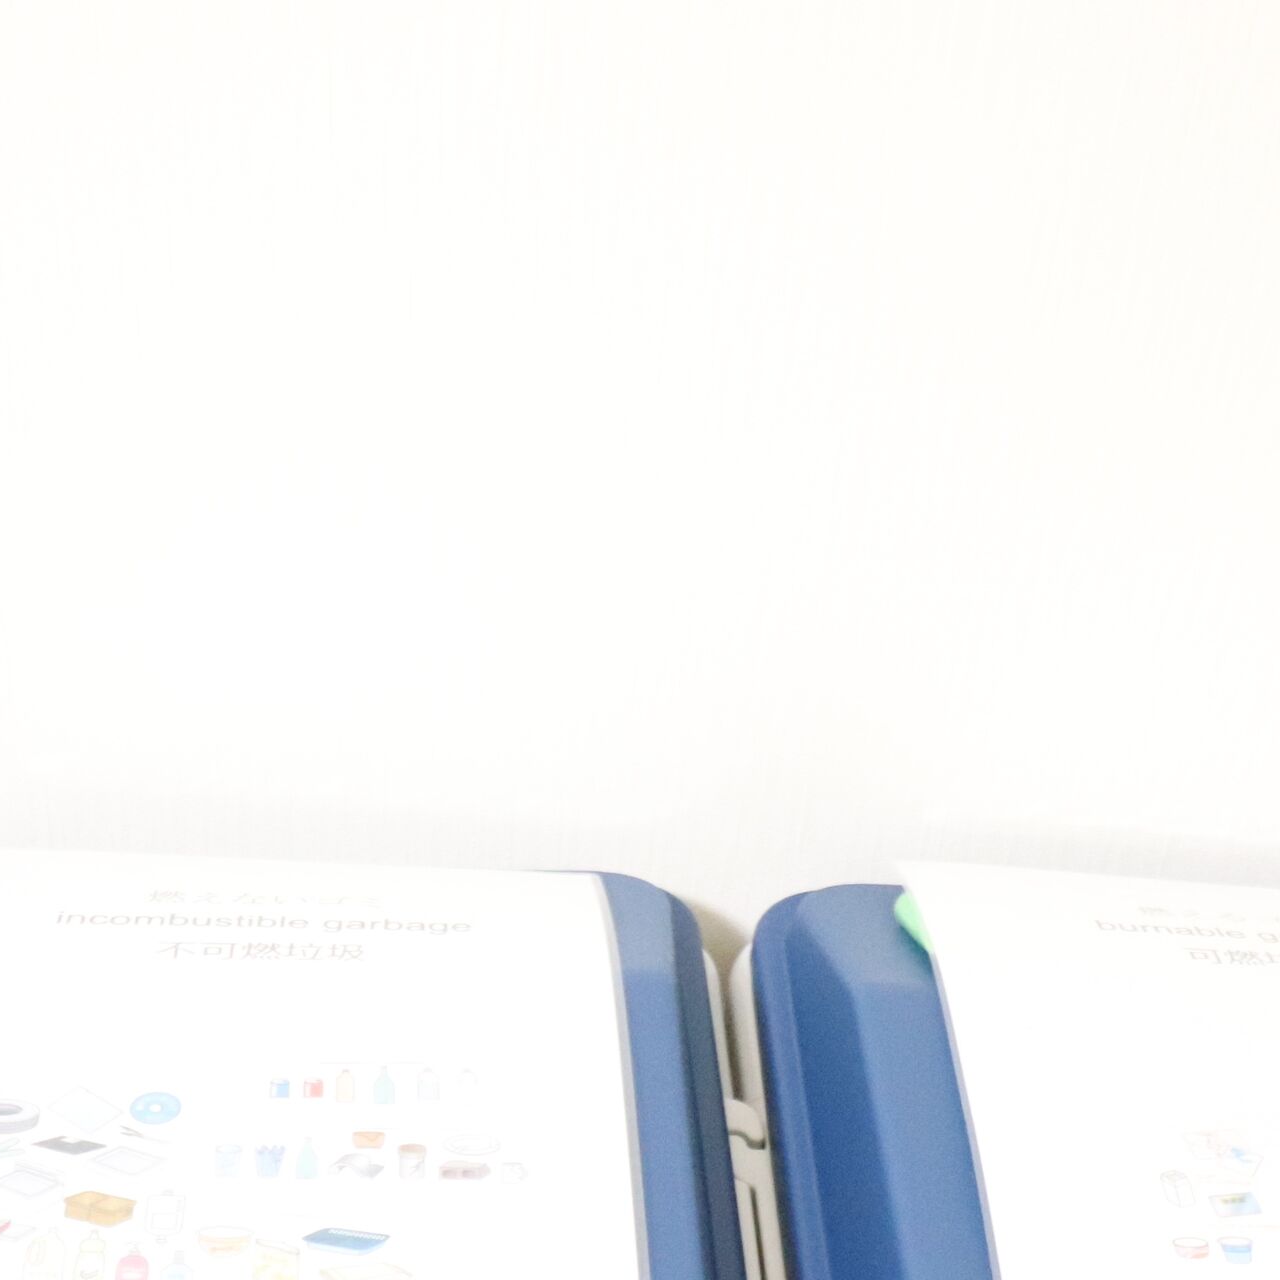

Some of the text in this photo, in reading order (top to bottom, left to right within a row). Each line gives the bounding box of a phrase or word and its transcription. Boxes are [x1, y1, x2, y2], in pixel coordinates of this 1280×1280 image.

[56, 911, 473, 935] incombustible garbage
[1094, 919, 1247, 940] burnable
[157, 941, 365, 961] 不可燃垃圾
